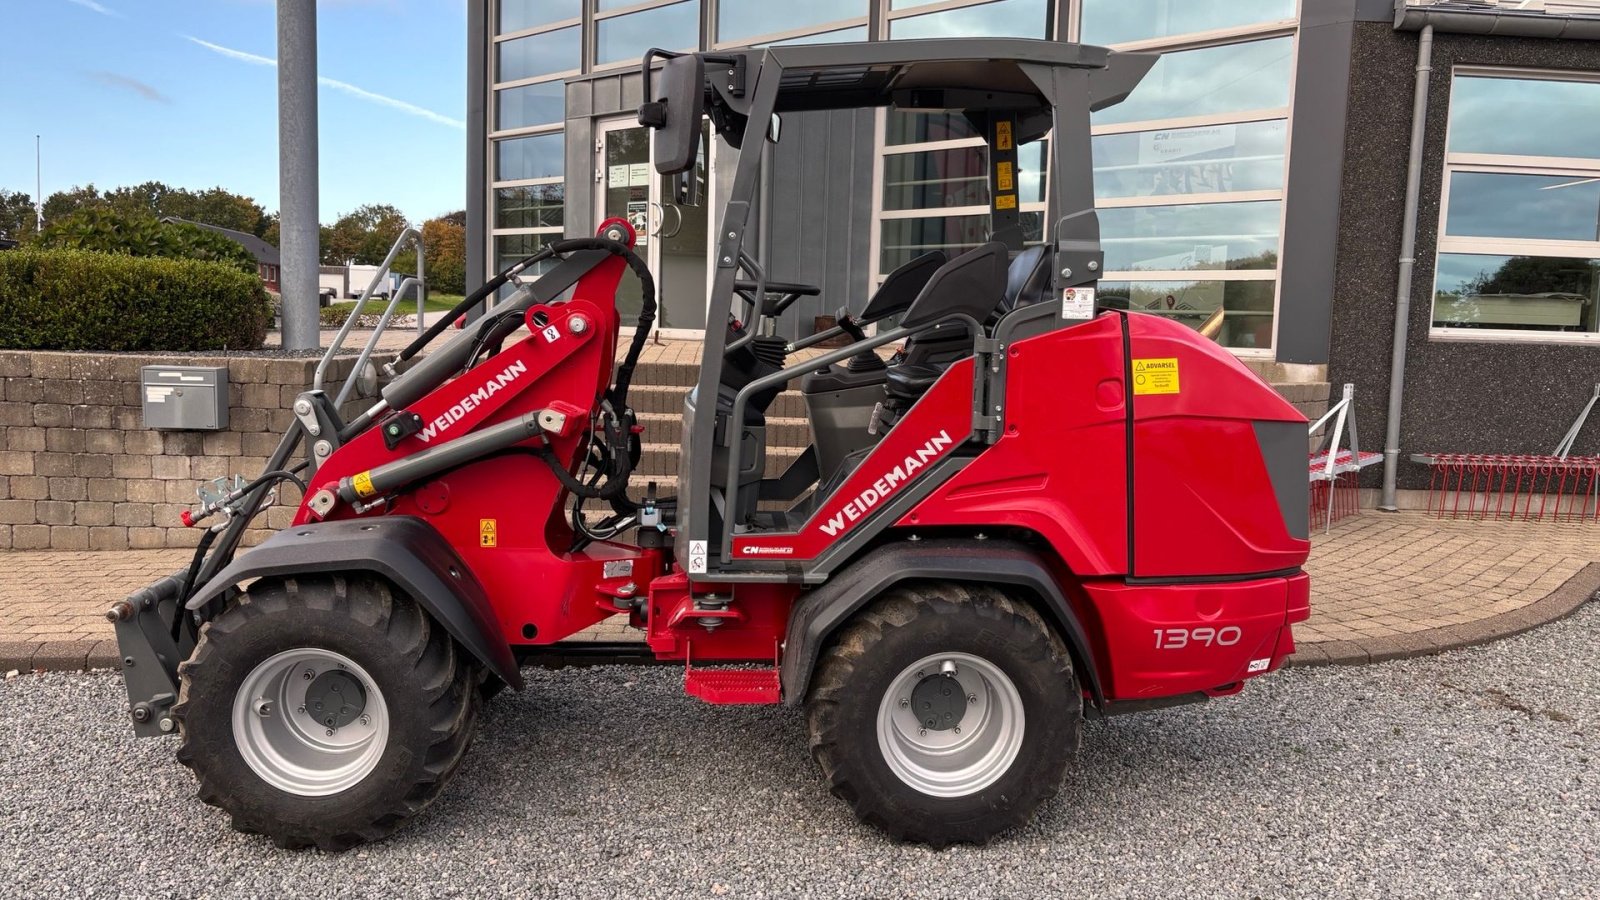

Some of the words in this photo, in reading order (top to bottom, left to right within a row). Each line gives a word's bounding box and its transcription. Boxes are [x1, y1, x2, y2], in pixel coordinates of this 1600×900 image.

[1154, 132, 1170, 140] CN
[414, 359, 527, 443] WEIDEMANN
[819, 429, 953, 536] WEIDEMANN
[743, 546, 759, 554] CN
[1153, 626, 1242, 649] 1390
